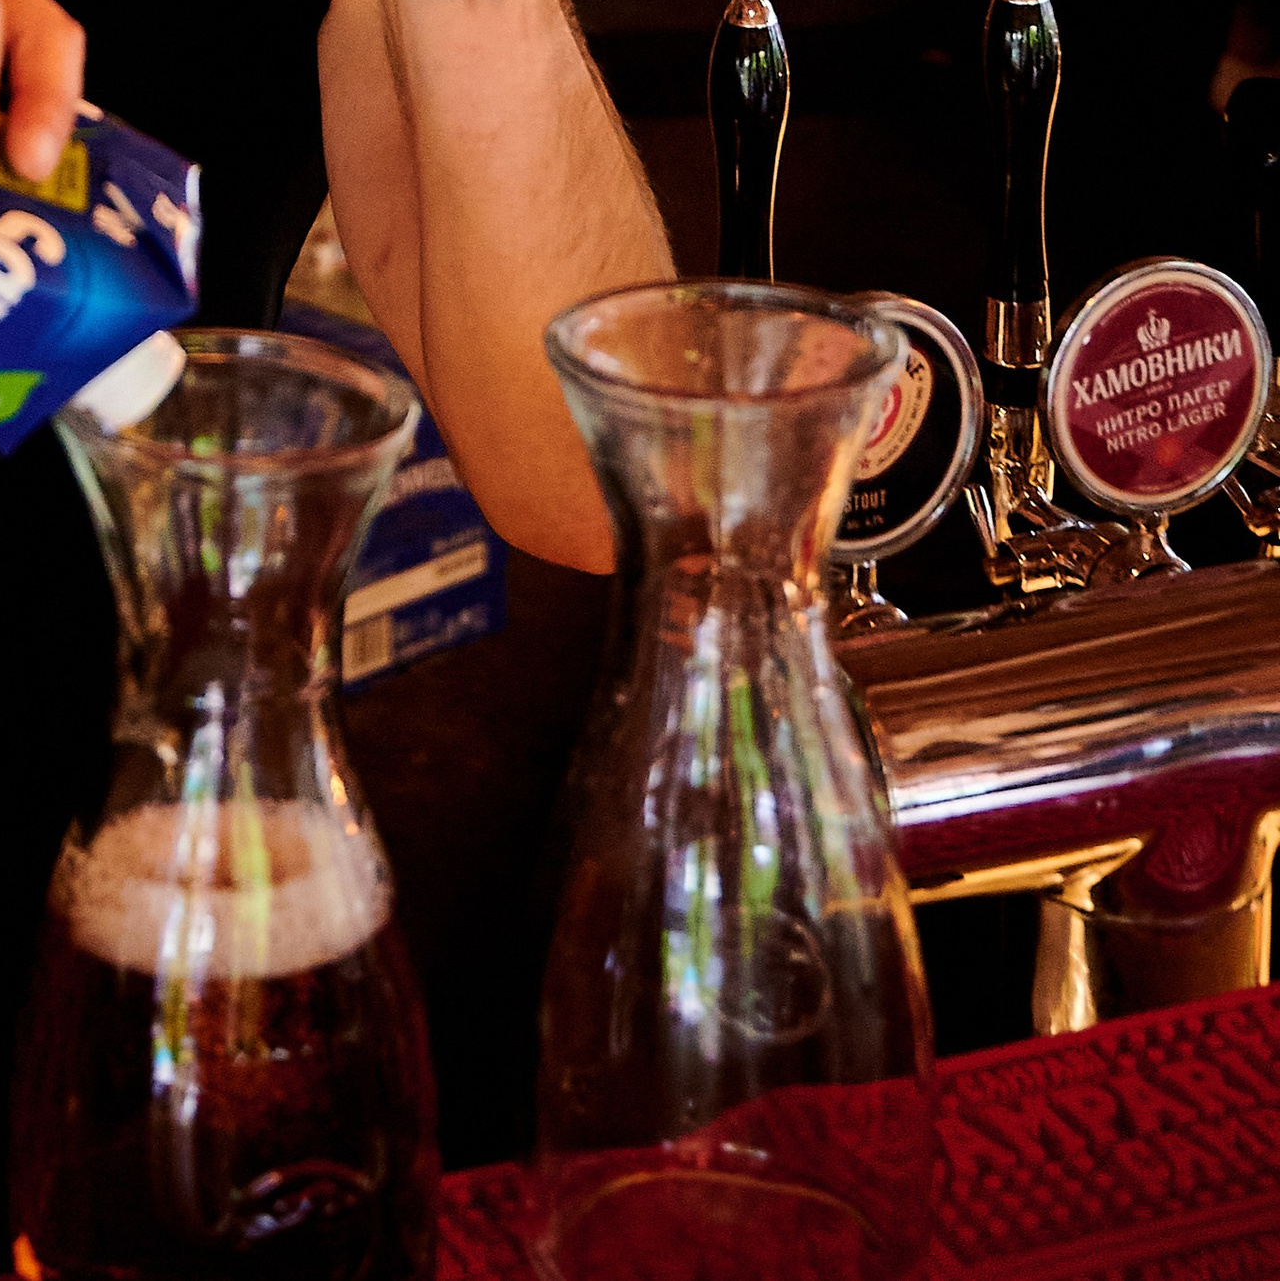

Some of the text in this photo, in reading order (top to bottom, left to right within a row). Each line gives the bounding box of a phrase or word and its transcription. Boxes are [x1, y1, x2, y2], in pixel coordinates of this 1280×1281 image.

[1072, 329, 1243, 409] ХАМОВНИКИ
[1096, 400, 1161, 436] НИТРО
[1106, 401, 1226, 454] NITRO LAGER
